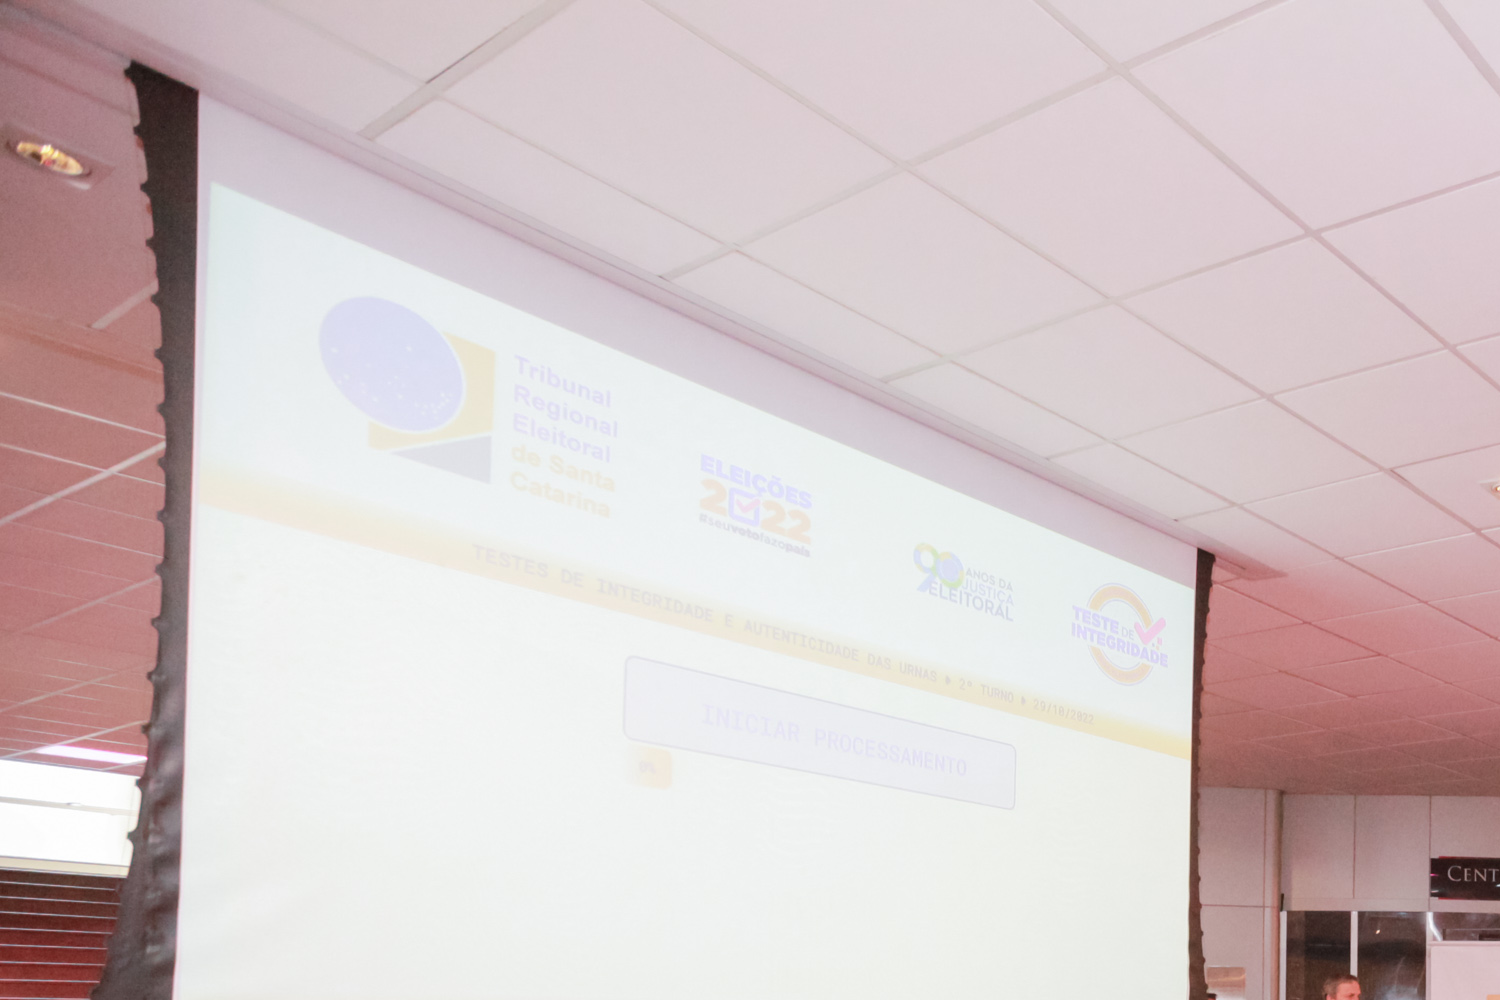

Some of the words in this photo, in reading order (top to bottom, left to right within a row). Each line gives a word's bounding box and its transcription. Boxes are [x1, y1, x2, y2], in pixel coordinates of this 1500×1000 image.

[514, 354, 611, 408] Tribunal
[514, 384, 618, 438] Regional
[513, 412, 610, 463] Eleitoral
[511, 445, 541, 467] de
[549, 454, 615, 492] Santa
[700, 453, 812, 509] ELEIÇÕES
[509, 471, 610, 518] Catarina
[928, 579, 1014, 622] ELEITORAL
[961, 578, 1014, 606] JUSTIÇA
[965, 567, 996, 586] ANOS
[998, 578, 1013, 592] DA
[471, 543, 549, 579] TESTES
[560, 568, 585, 588] DE
[596, 577, 714, 623] INTEGRIDADE
[724, 613, 734, 628] E
[743, 619, 860, 662] AUTENTICIDADE
[866, 651, 893, 671] DAS
[900, 662, 938, 683] URNAS
[980, 683, 1015, 704] TURNO
[1071, 604, 1120, 635] TESTE
[1121, 626, 1135, 641] DE
[1071, 622, 1169, 668] INTEGRIDADE
[701, 703, 800, 743] INICIAR
[814, 727, 968, 777] PROCESSAMENTO
